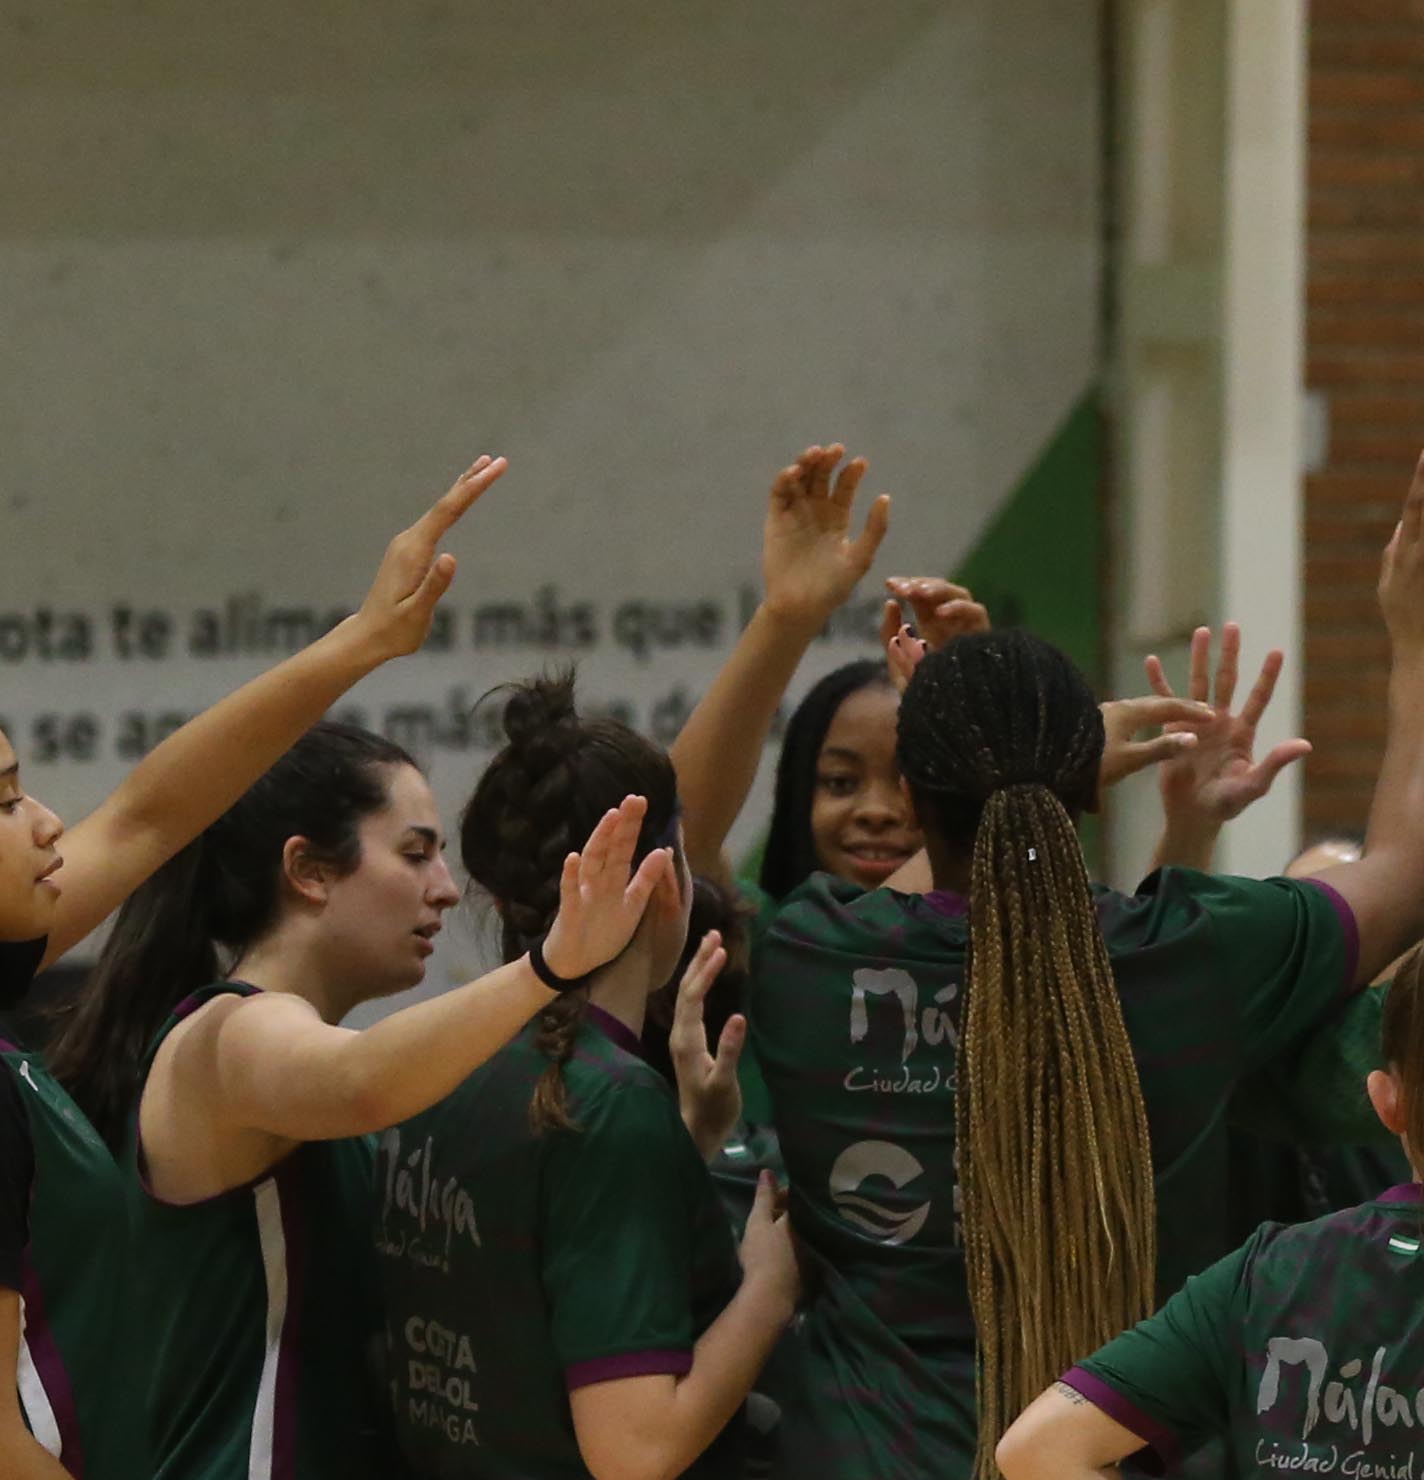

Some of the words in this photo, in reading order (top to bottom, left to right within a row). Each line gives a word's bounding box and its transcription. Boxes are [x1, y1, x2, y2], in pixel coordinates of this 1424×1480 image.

[112, 602, 175, 662] te
[187, 590, 454, 660] alima
[473, 582, 594, 650] más
[612, 599, 719, 664] que
[32, 711, 100, 764] se
[843, 1065, 940, 1093] Ciudad
[1255, 1438, 1339, 1473] Ciudad
